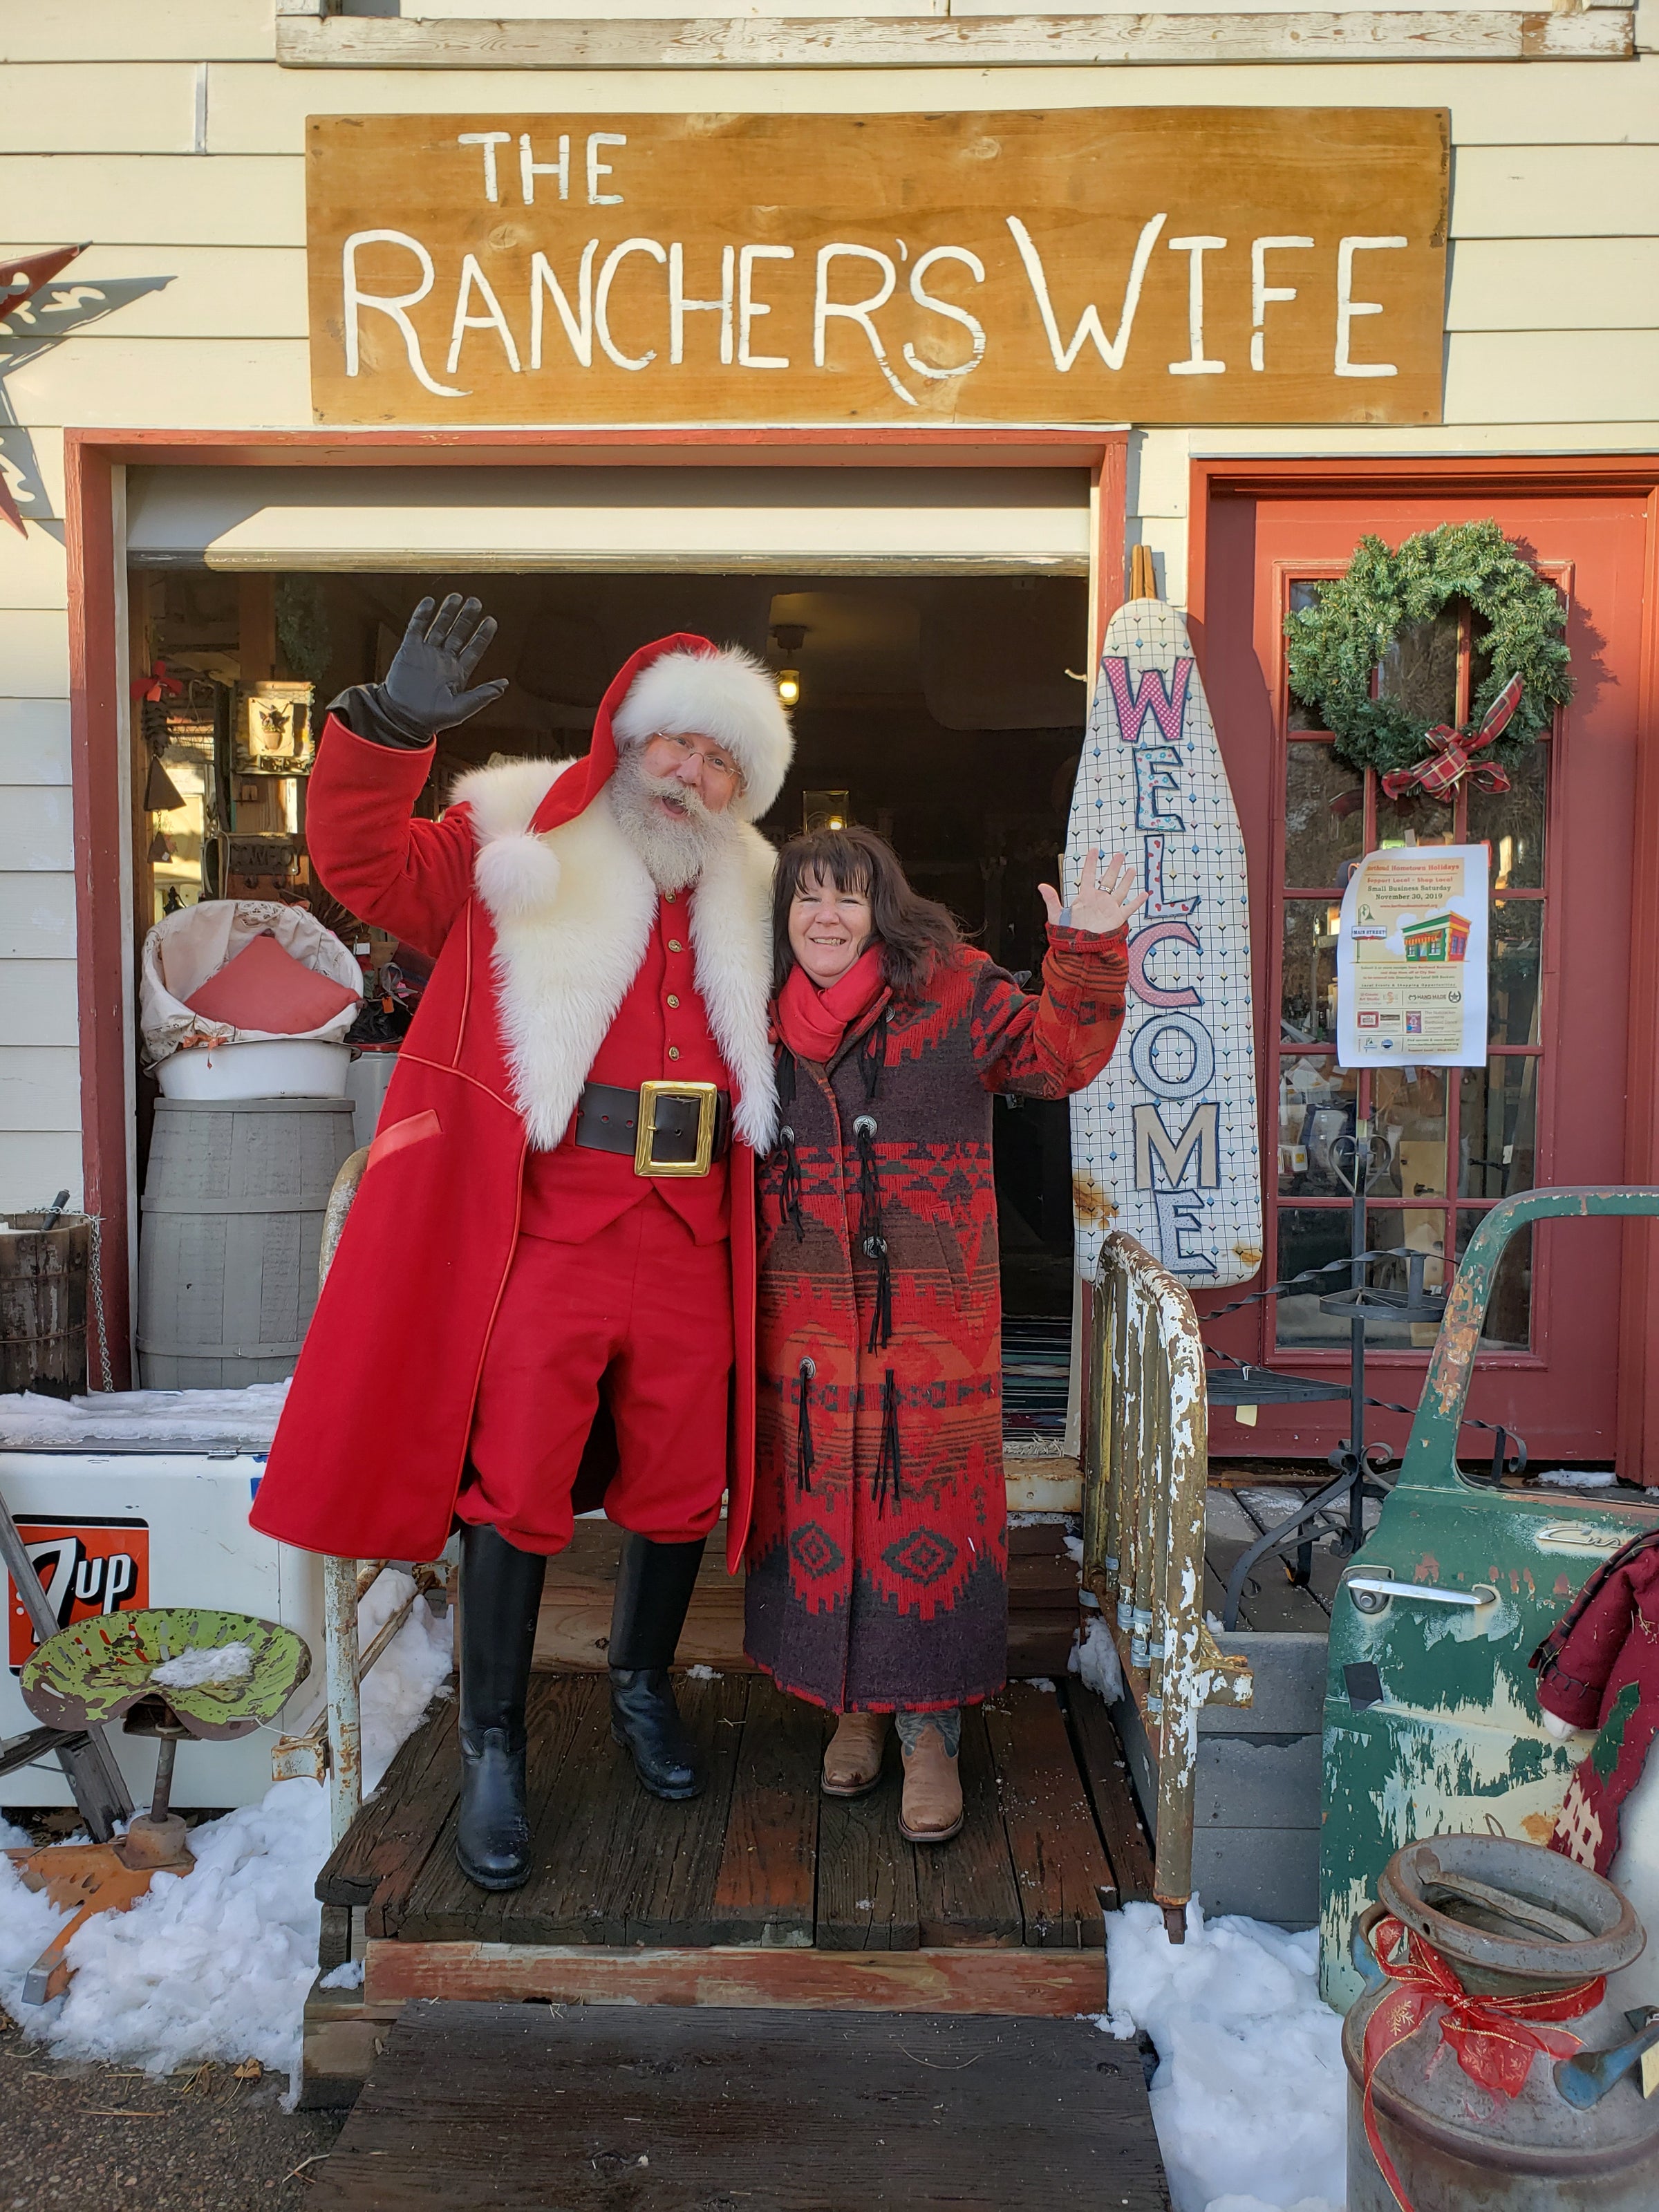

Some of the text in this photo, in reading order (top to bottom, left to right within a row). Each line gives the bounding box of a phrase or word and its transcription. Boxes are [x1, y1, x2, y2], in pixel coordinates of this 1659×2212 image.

[458, 131, 627, 205] THE
[343, 213, 1407, 407] RANCHER'S WIFE
[1101, 655, 1221, 1275] WELCOME
